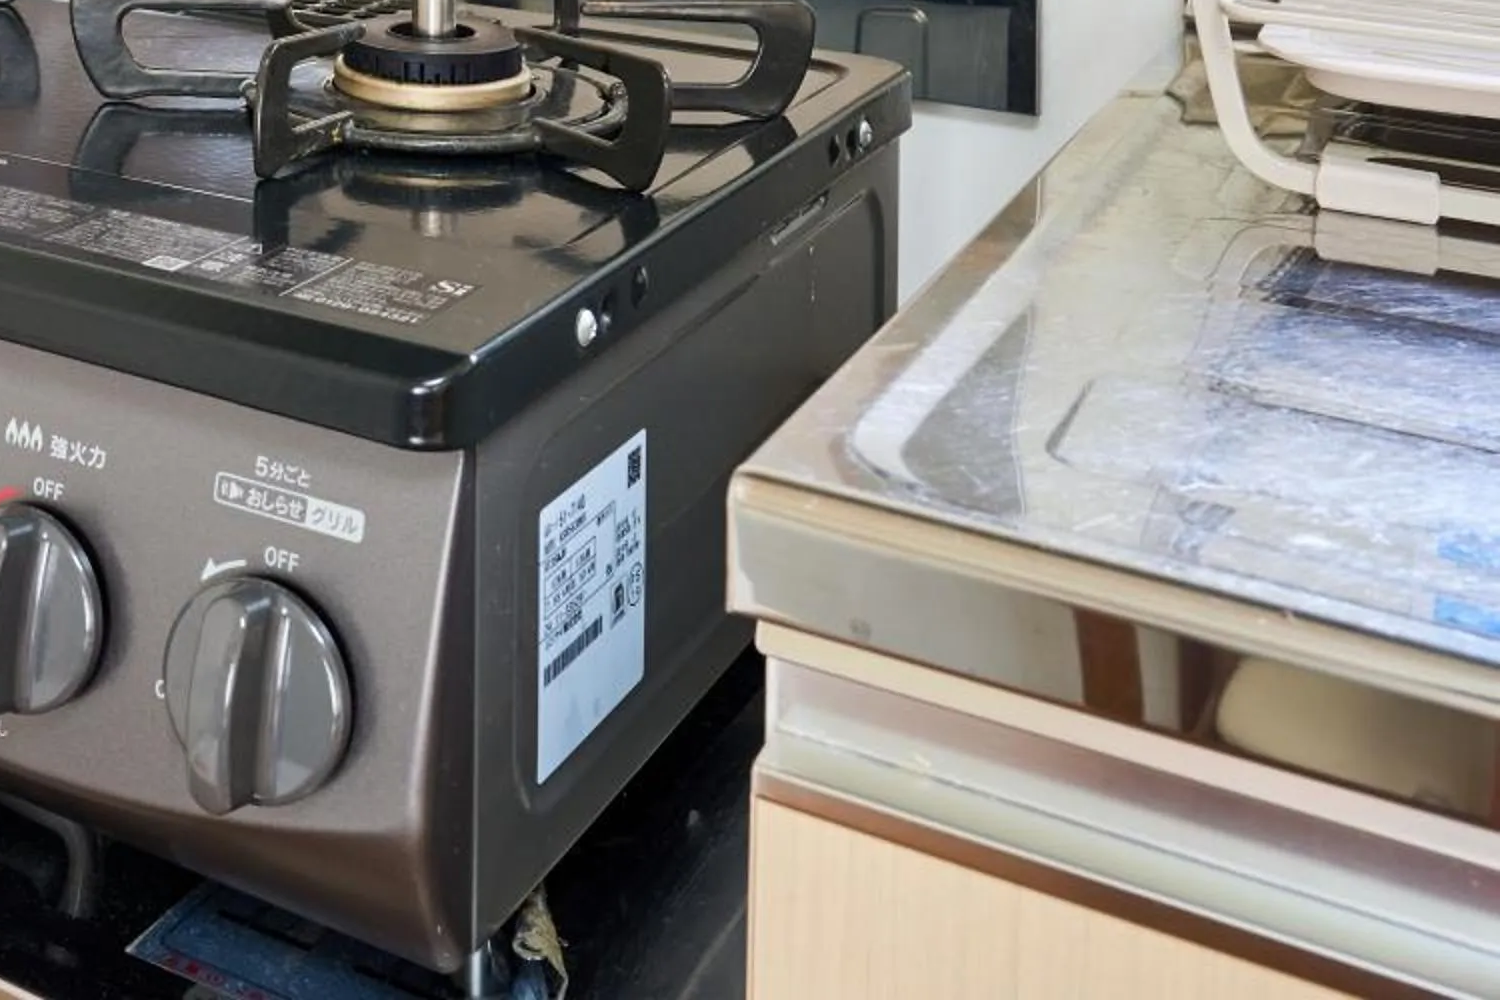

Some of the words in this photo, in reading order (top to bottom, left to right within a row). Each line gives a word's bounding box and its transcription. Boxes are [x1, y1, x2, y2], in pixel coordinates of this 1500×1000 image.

[50, 434, 106, 469] 強火力
[254, 455, 313, 488] 5分ごと
[32, 476, 65, 501] OFF
[264, 545, 300, 573] OFF
